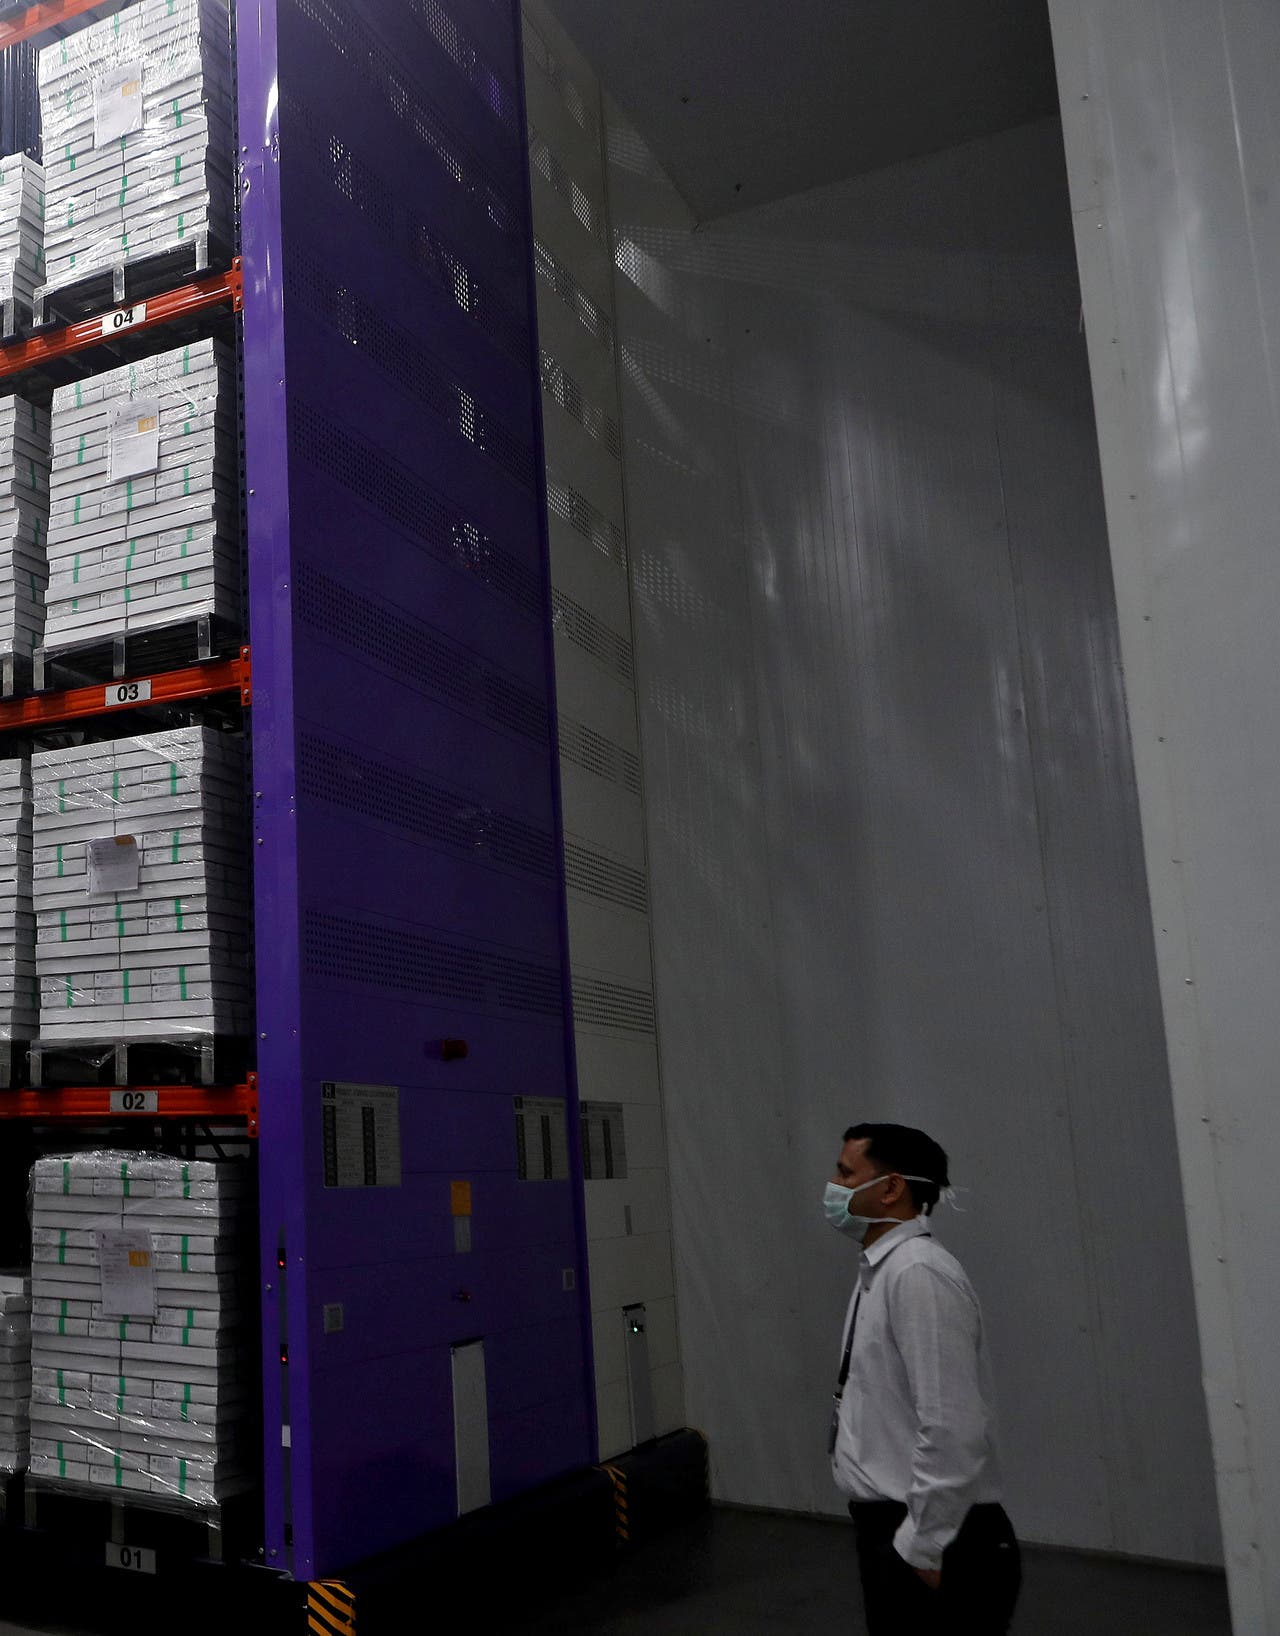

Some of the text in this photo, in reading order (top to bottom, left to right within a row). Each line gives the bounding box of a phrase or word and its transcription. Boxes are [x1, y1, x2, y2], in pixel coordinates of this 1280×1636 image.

[113, 309, 134, 328] 04
[117, 684, 139, 702] 03
[122, 1092, 145, 1110] 02
[119, 1547, 142, 1569] 01
